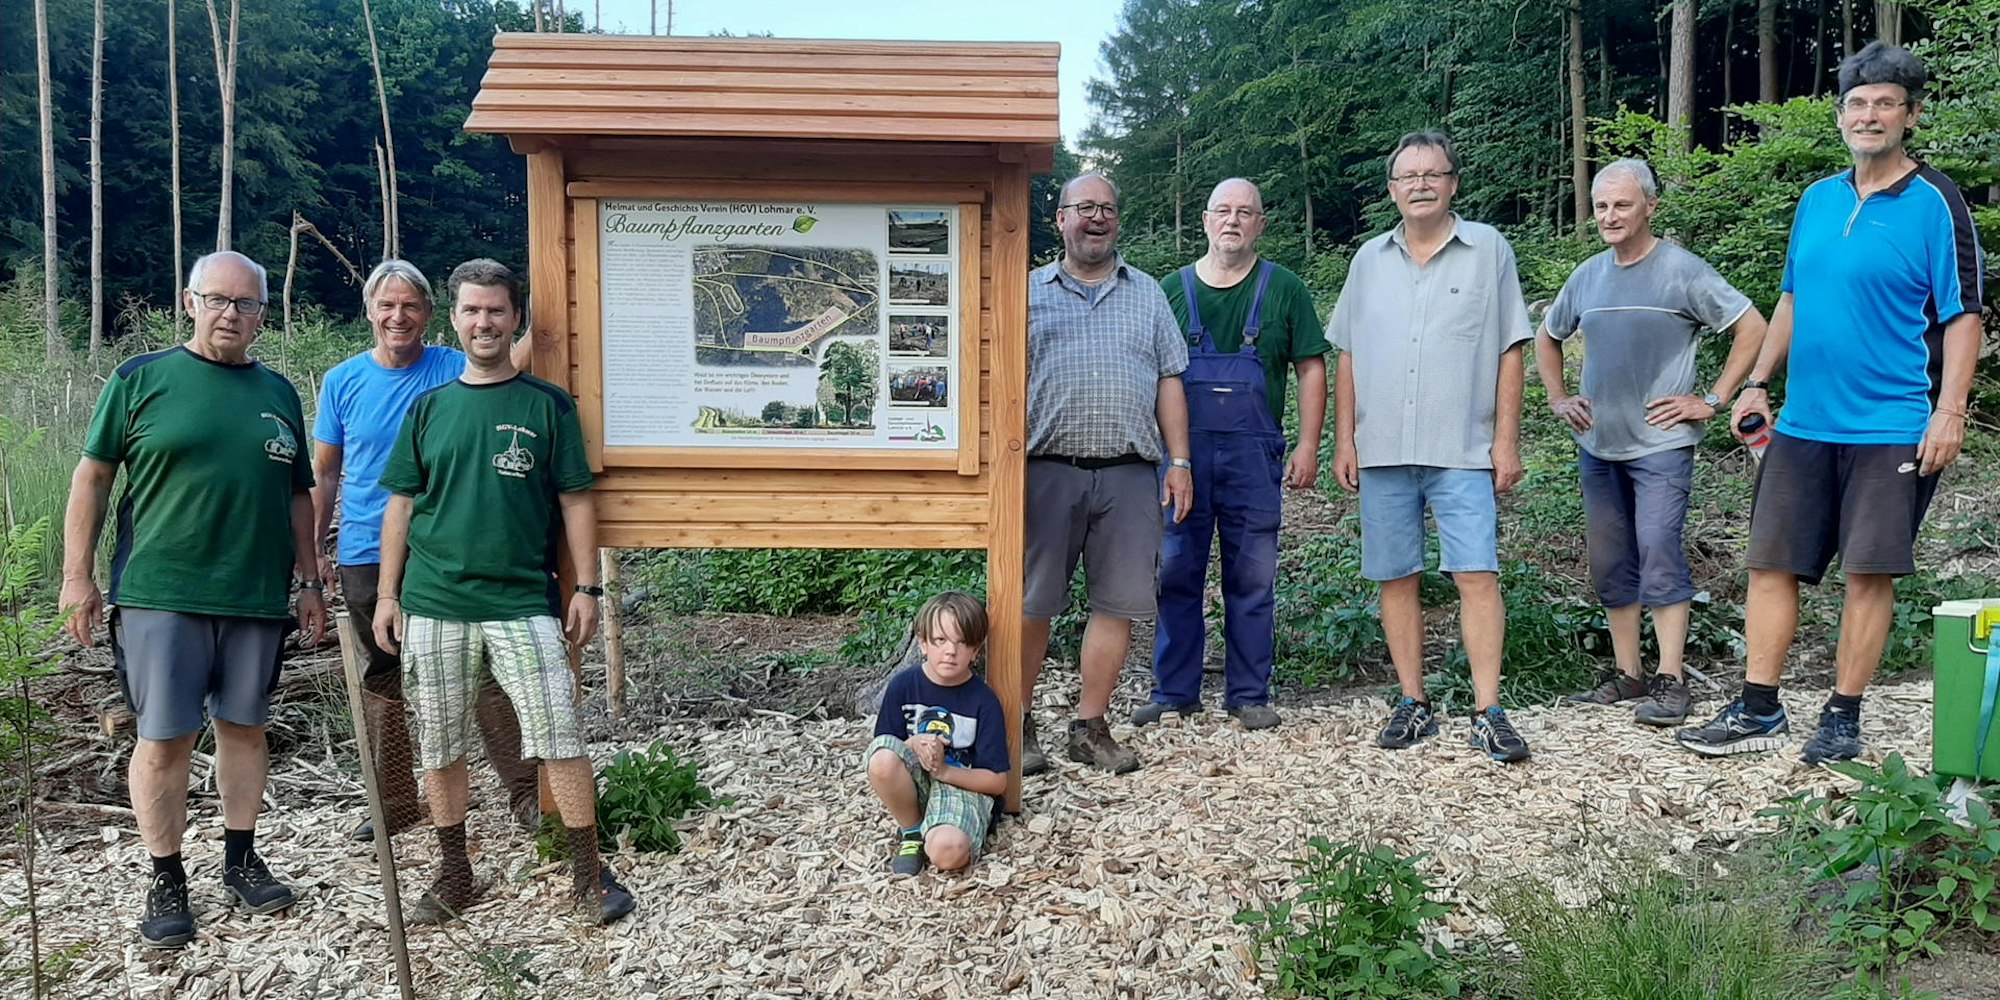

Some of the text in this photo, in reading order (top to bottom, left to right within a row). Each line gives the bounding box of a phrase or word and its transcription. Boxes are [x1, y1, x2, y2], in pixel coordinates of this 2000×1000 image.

[605, 202, 635, 211] Heimat
[637, 204, 653, 212] und
[654, 202, 699, 212] Geschichts
[700, 203, 728, 213] Verein
[729, 203, 757, 214] (HGV)
[759, 205, 794, 214] Lohmar
[605, 213, 786, 243] Baumpflanzgarten
[752, 314, 832, 347] Baumpflanzgarten
